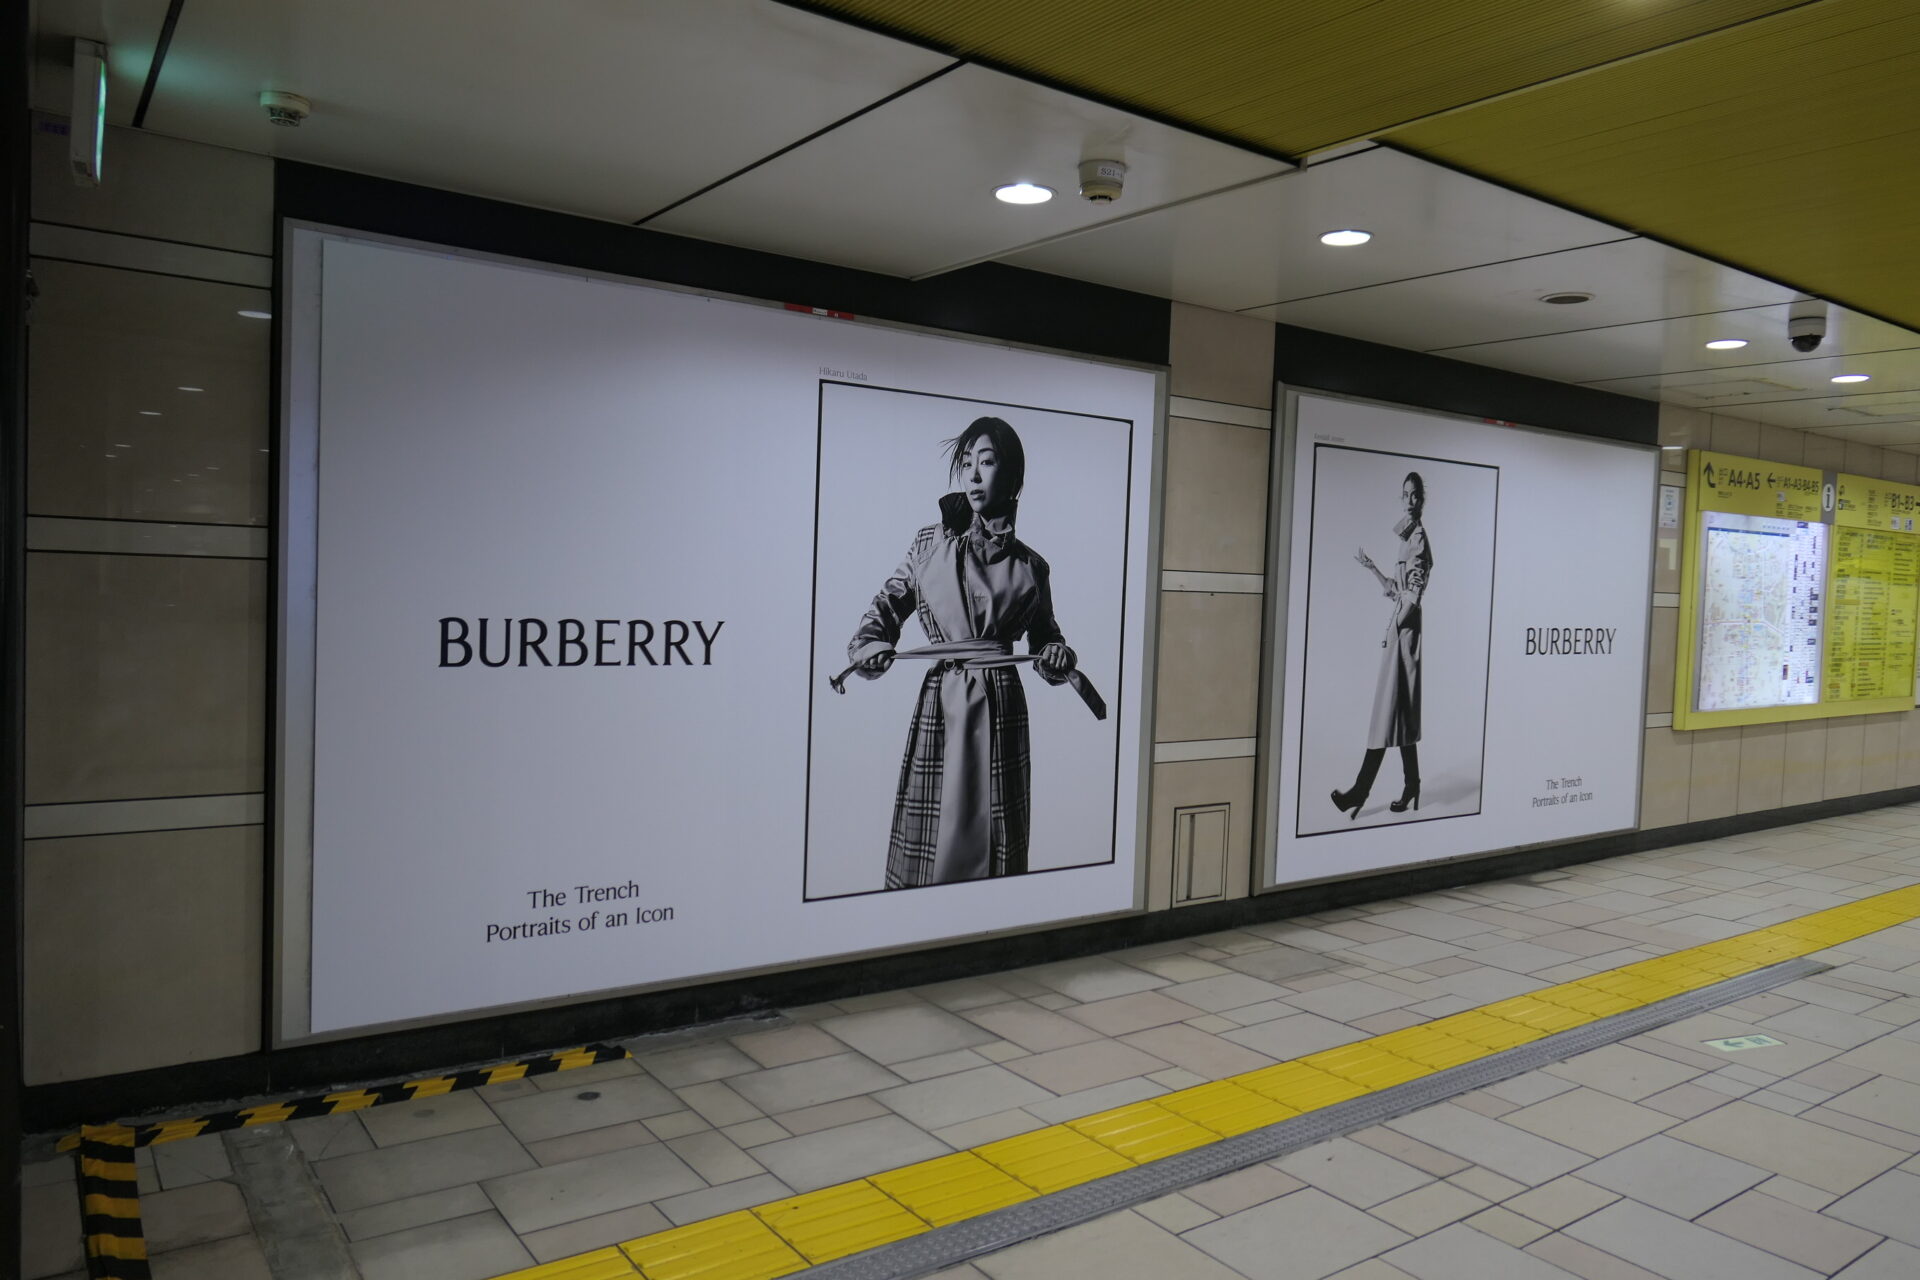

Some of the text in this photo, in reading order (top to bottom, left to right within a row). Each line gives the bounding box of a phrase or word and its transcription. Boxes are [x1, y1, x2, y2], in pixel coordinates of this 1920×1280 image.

[818, 366, 868, 382] Hikaru Utada
[438, 617, 725, 668] BURBERRY
[1526, 628, 1616, 656] BURBERRY
[1546, 777, 1582, 790] The Trench
[1532, 794, 1560, 809] Portraits
[1560, 792, 1570, 805] of
[1570, 793, 1578, 804] an
[527, 880, 640, 909] The Trench
[486, 907, 674, 943] Portraits of an Icon
